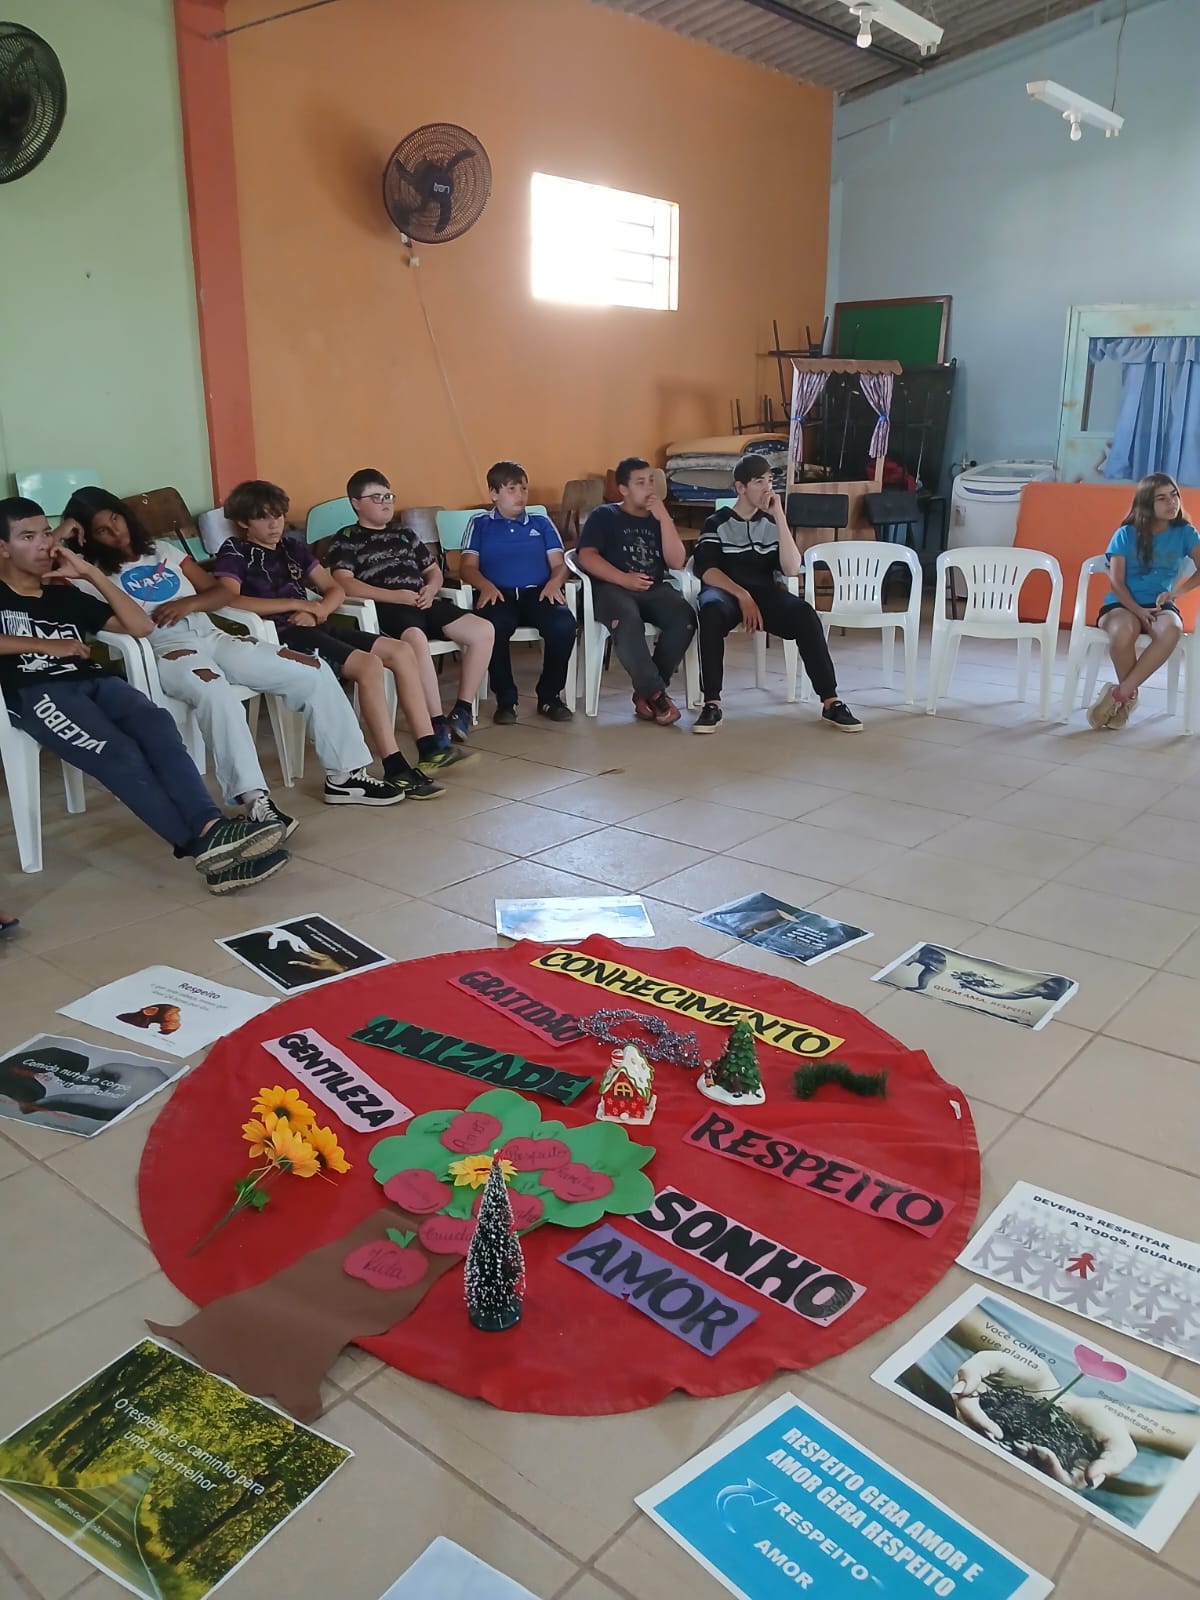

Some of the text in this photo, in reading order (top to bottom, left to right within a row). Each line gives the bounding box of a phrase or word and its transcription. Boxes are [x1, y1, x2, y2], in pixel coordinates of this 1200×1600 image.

[127, 572, 175, 591] NASA
[178, 982, 221, 1000] Respeito
[539, 949, 831, 1054] CONHECIMENTO
[933, 984, 963, 996] QUEM
[278, 1033, 395, 1127] GENTILEZA
[352, 1018, 588, 1096] AMIZADE
[690, 1111, 945, 1228] RESPEITO
[633, 1191, 856, 1319] SONHO
[1033, 1195, 1171, 1250] DEVEMOS RESPEITAR
[1083, 1226, 1130, 1248] TODOS,
[566, 1238, 740, 1351] AMOR
[980, 1334, 1002, 1349] que
[1012, 1338, 1047, 1360] colhe
[114, 1398, 129, 1409] O
[124, 1406, 169, 1438] respeito
[177, 1439, 188, 1448] o
[187, 1444, 237, 1480] caminho
[233, 1474, 265, 1496] para
[1136, 1412, 1159, 1428] para
[1160, 1425, 1177, 1436] ser
[124, 1430, 217, 1492] uma vida melhor
[766, 1448, 956, 1597] AMOR GERA RESPEITO
[781, 1426, 984, 1583] RESPEITO GERA AMOR E
[753, 1539, 814, 1591] AMOR
[773, 1501, 869, 1580] RESPEITO
